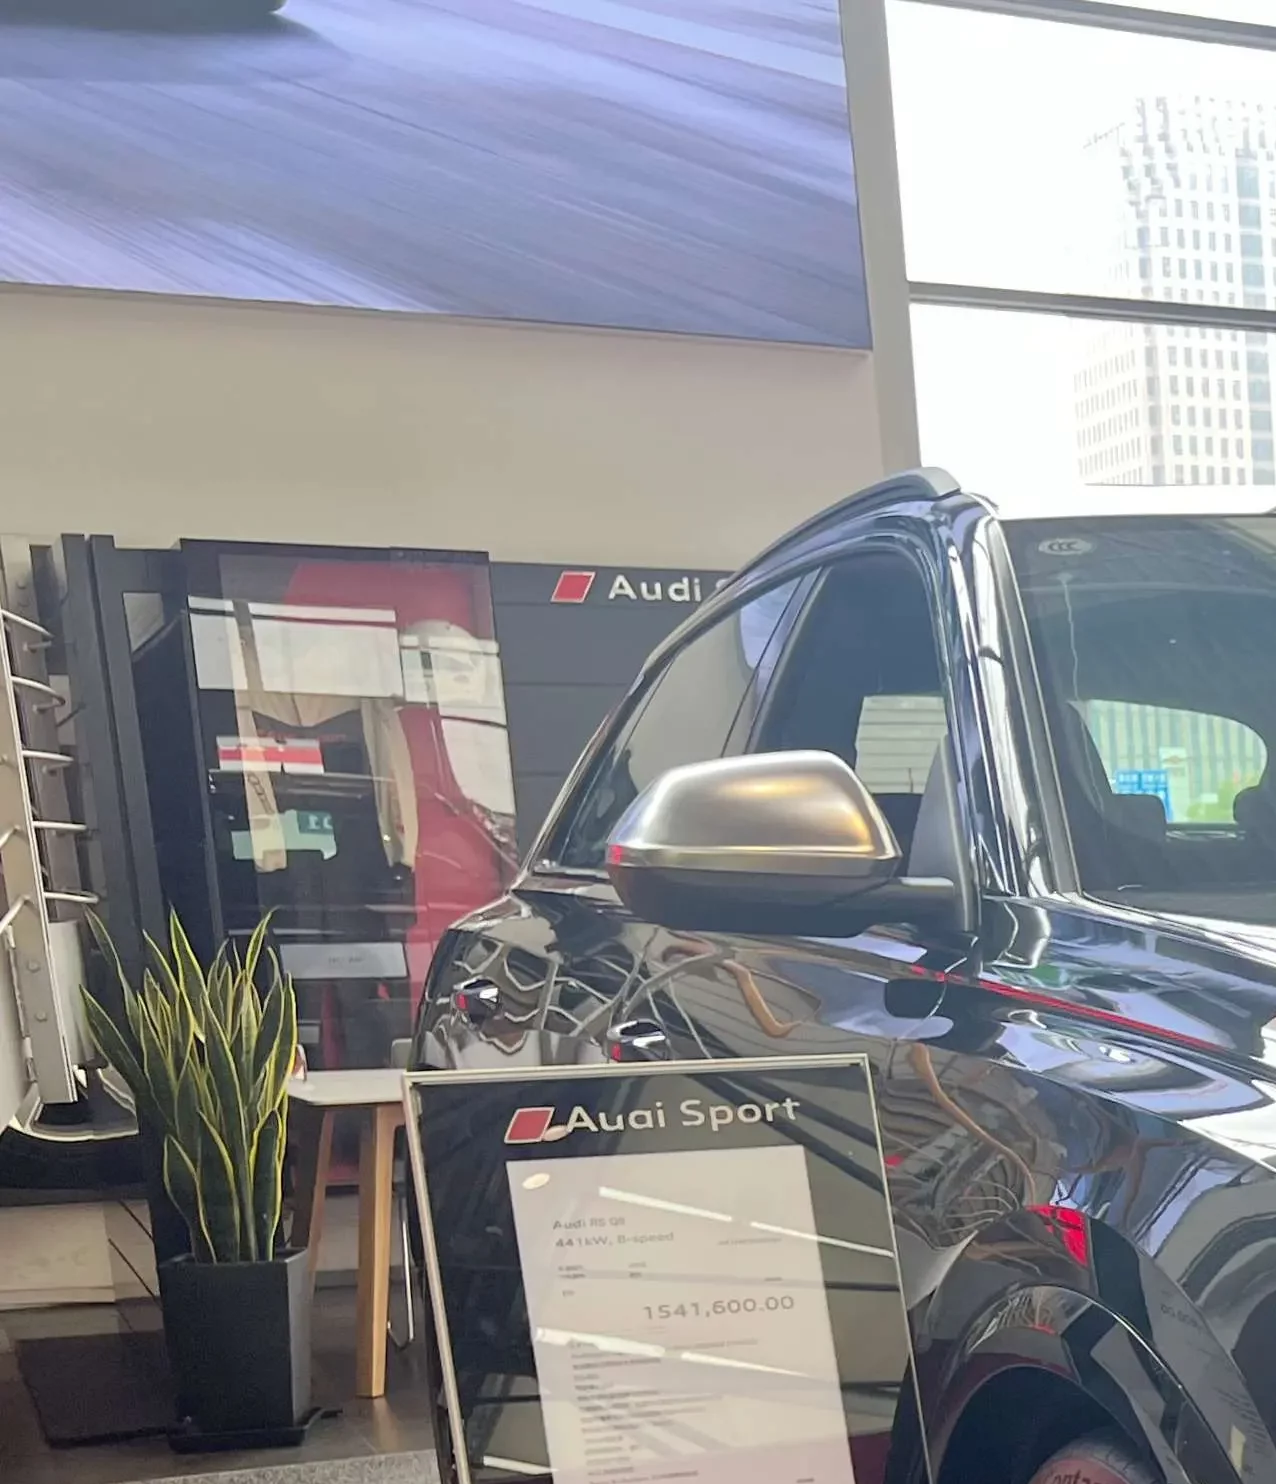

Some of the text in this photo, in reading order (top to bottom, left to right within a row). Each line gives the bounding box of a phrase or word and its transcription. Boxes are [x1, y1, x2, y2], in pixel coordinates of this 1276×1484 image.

[607, 573, 702, 603] Audi
[679, 1097, 800, 1132] Sport
[642, 1294, 796, 1320] 1541,600.00
